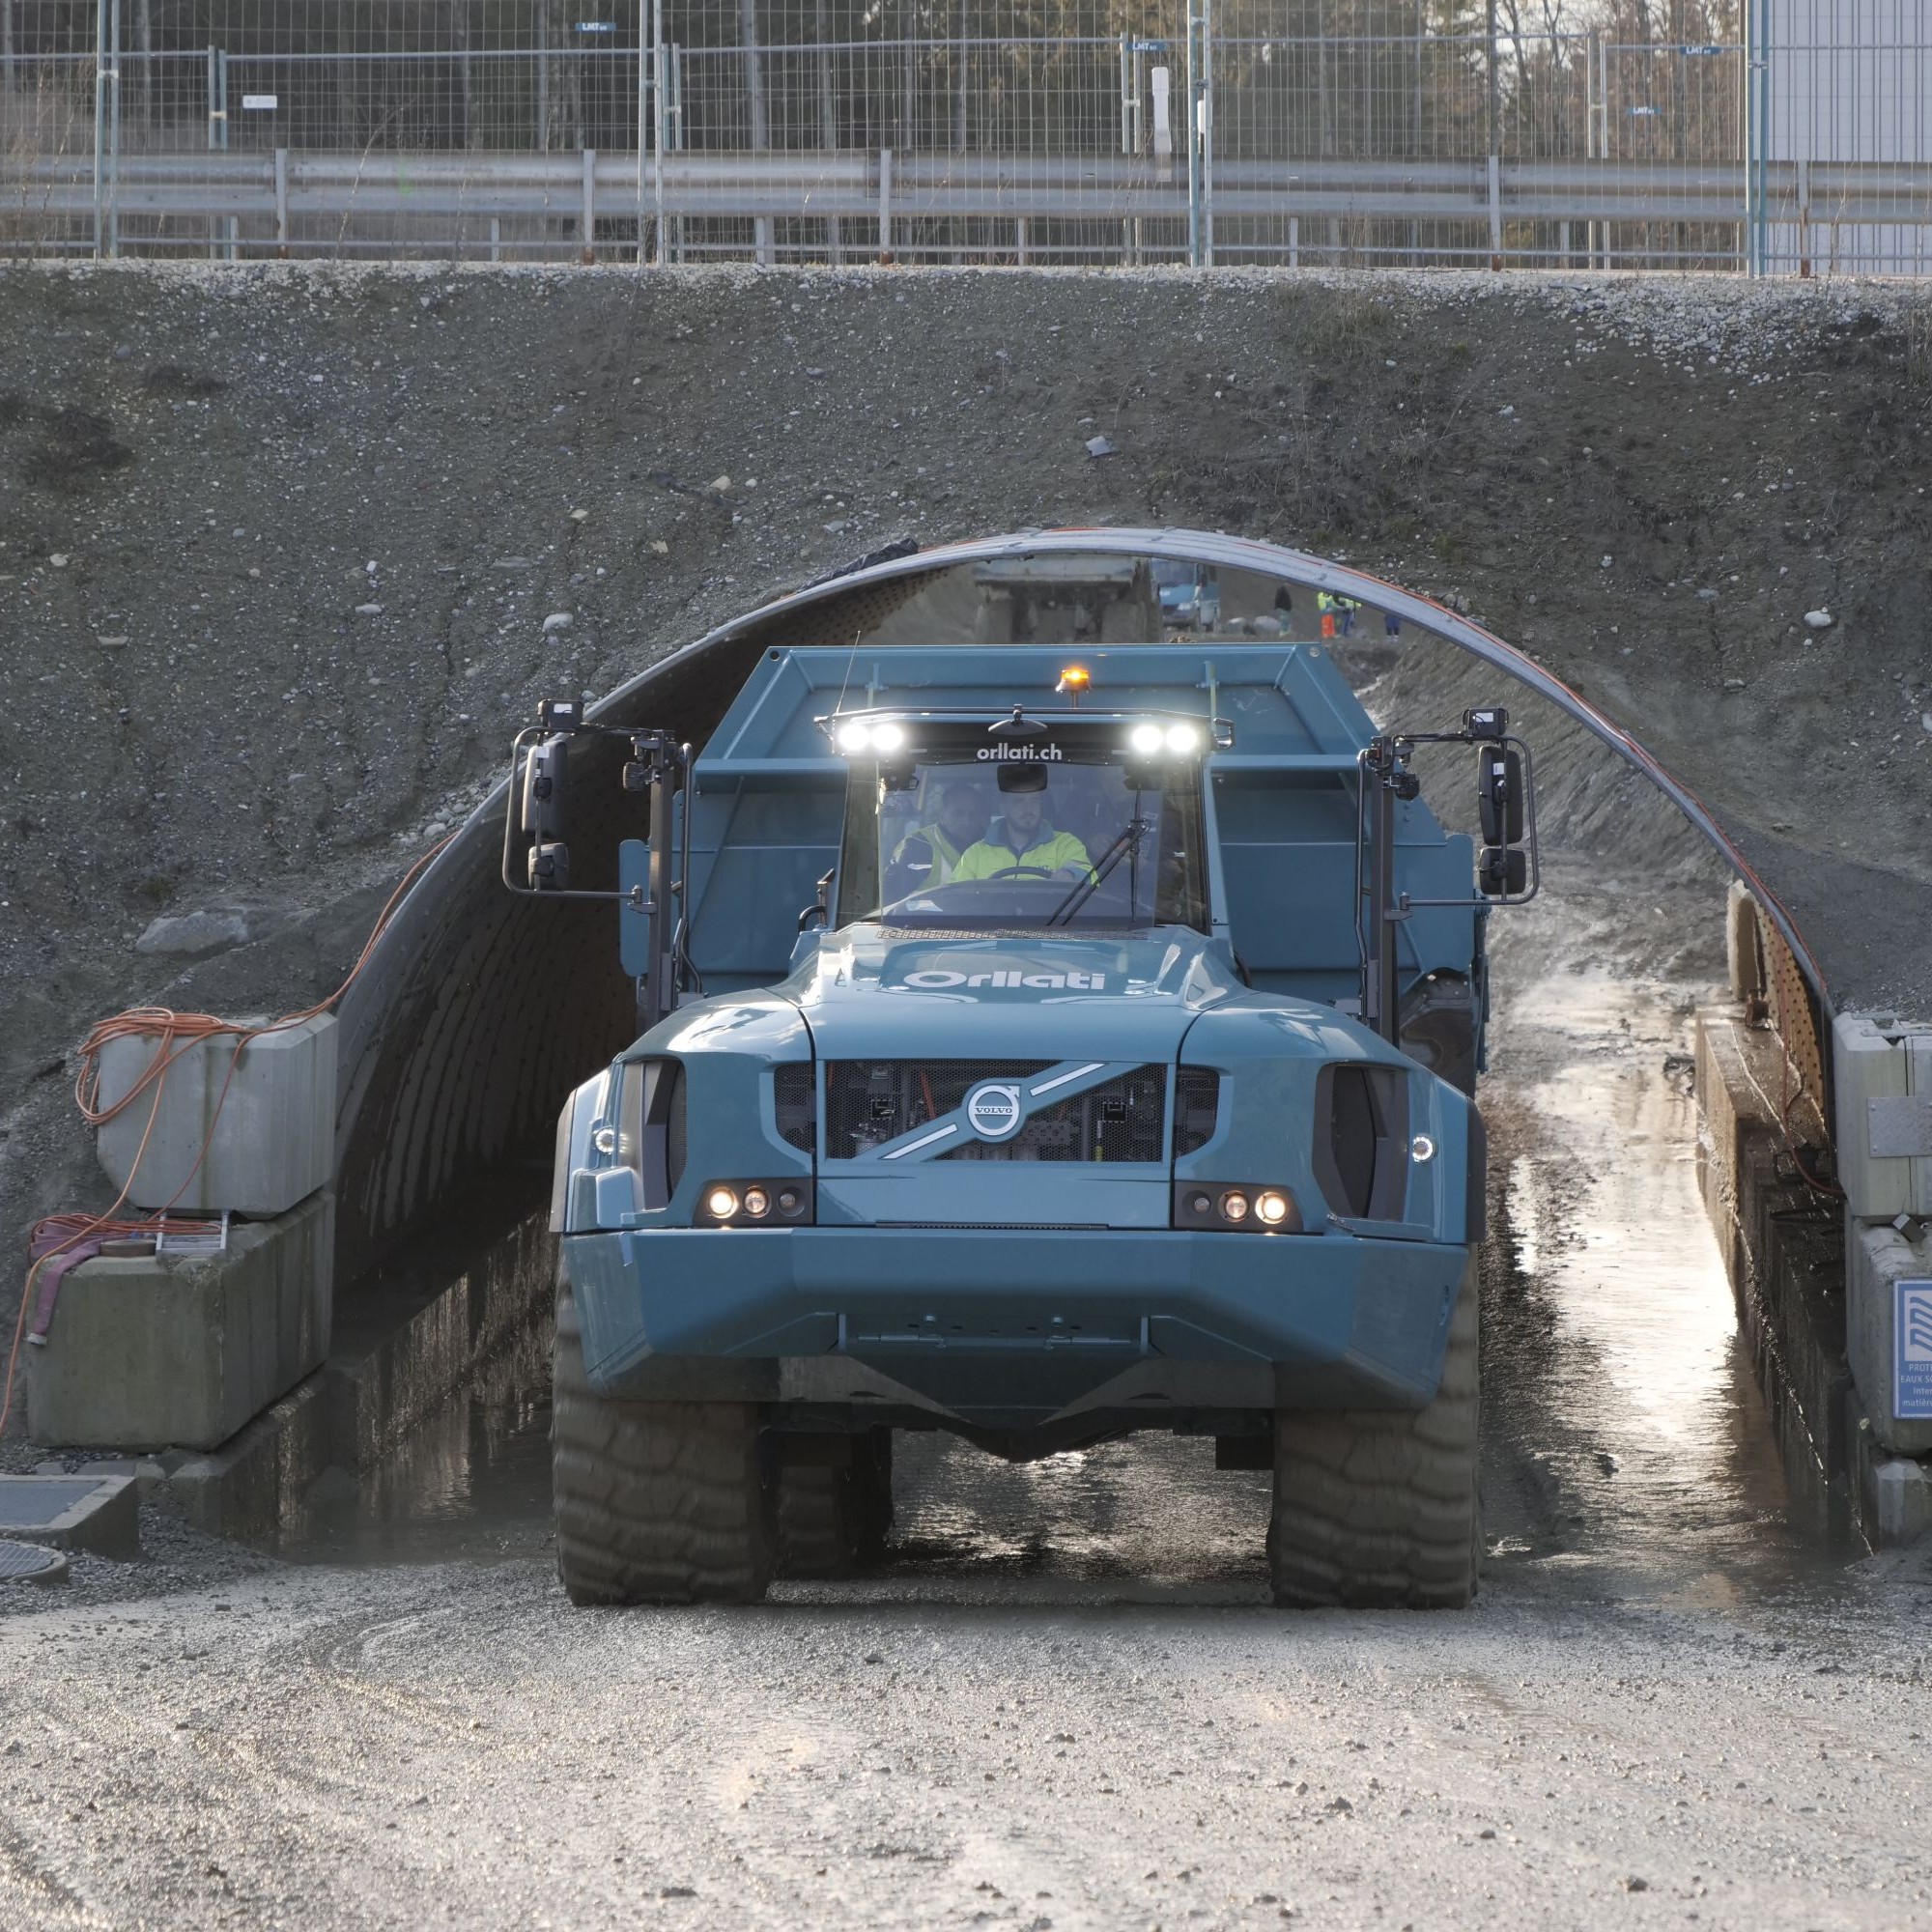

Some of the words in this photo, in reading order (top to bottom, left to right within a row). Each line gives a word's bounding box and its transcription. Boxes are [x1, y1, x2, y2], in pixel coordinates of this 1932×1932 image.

[582, 22, 599, 31] LMT
[977, 742, 1063, 760] orllati.ch
[903, 971, 1106, 990] Orllati
[1900, 1375, 1922, 1383] EAUX
